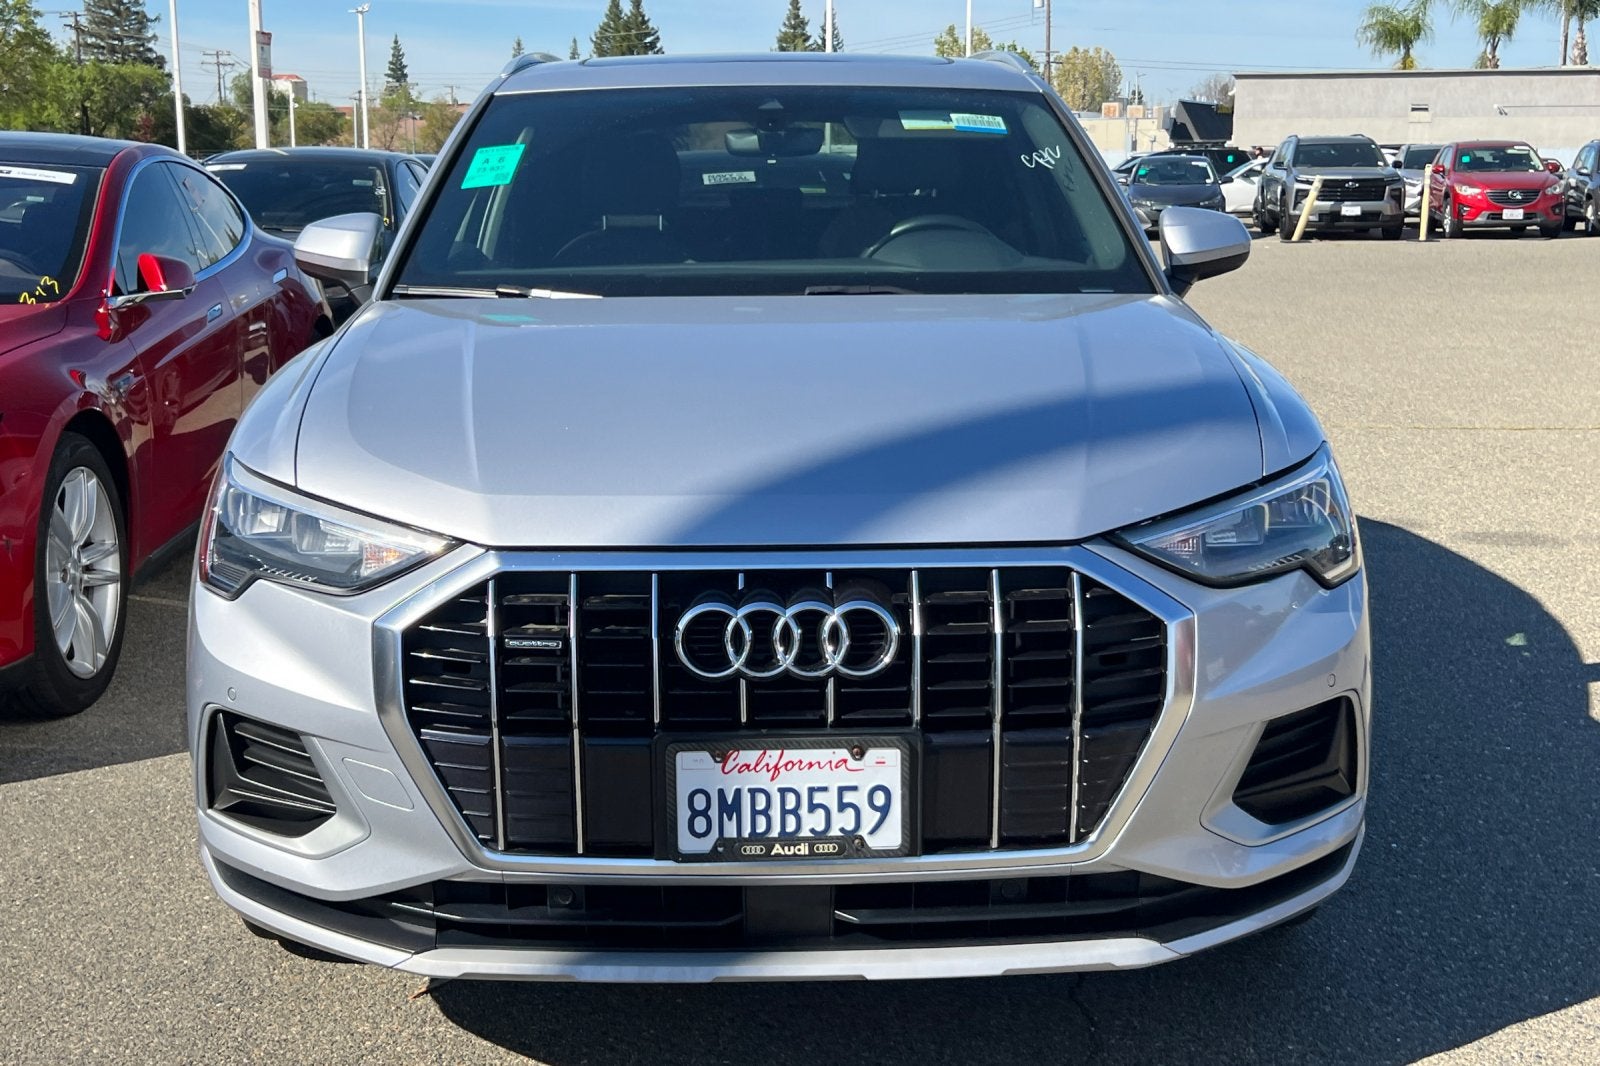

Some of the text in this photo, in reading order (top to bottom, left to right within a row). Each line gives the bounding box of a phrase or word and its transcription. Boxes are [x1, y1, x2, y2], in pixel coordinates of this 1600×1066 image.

[721, 749, 865, 782] California
[687, 784, 892, 839] 8MBB559
[770, 843, 809, 856] Audi
